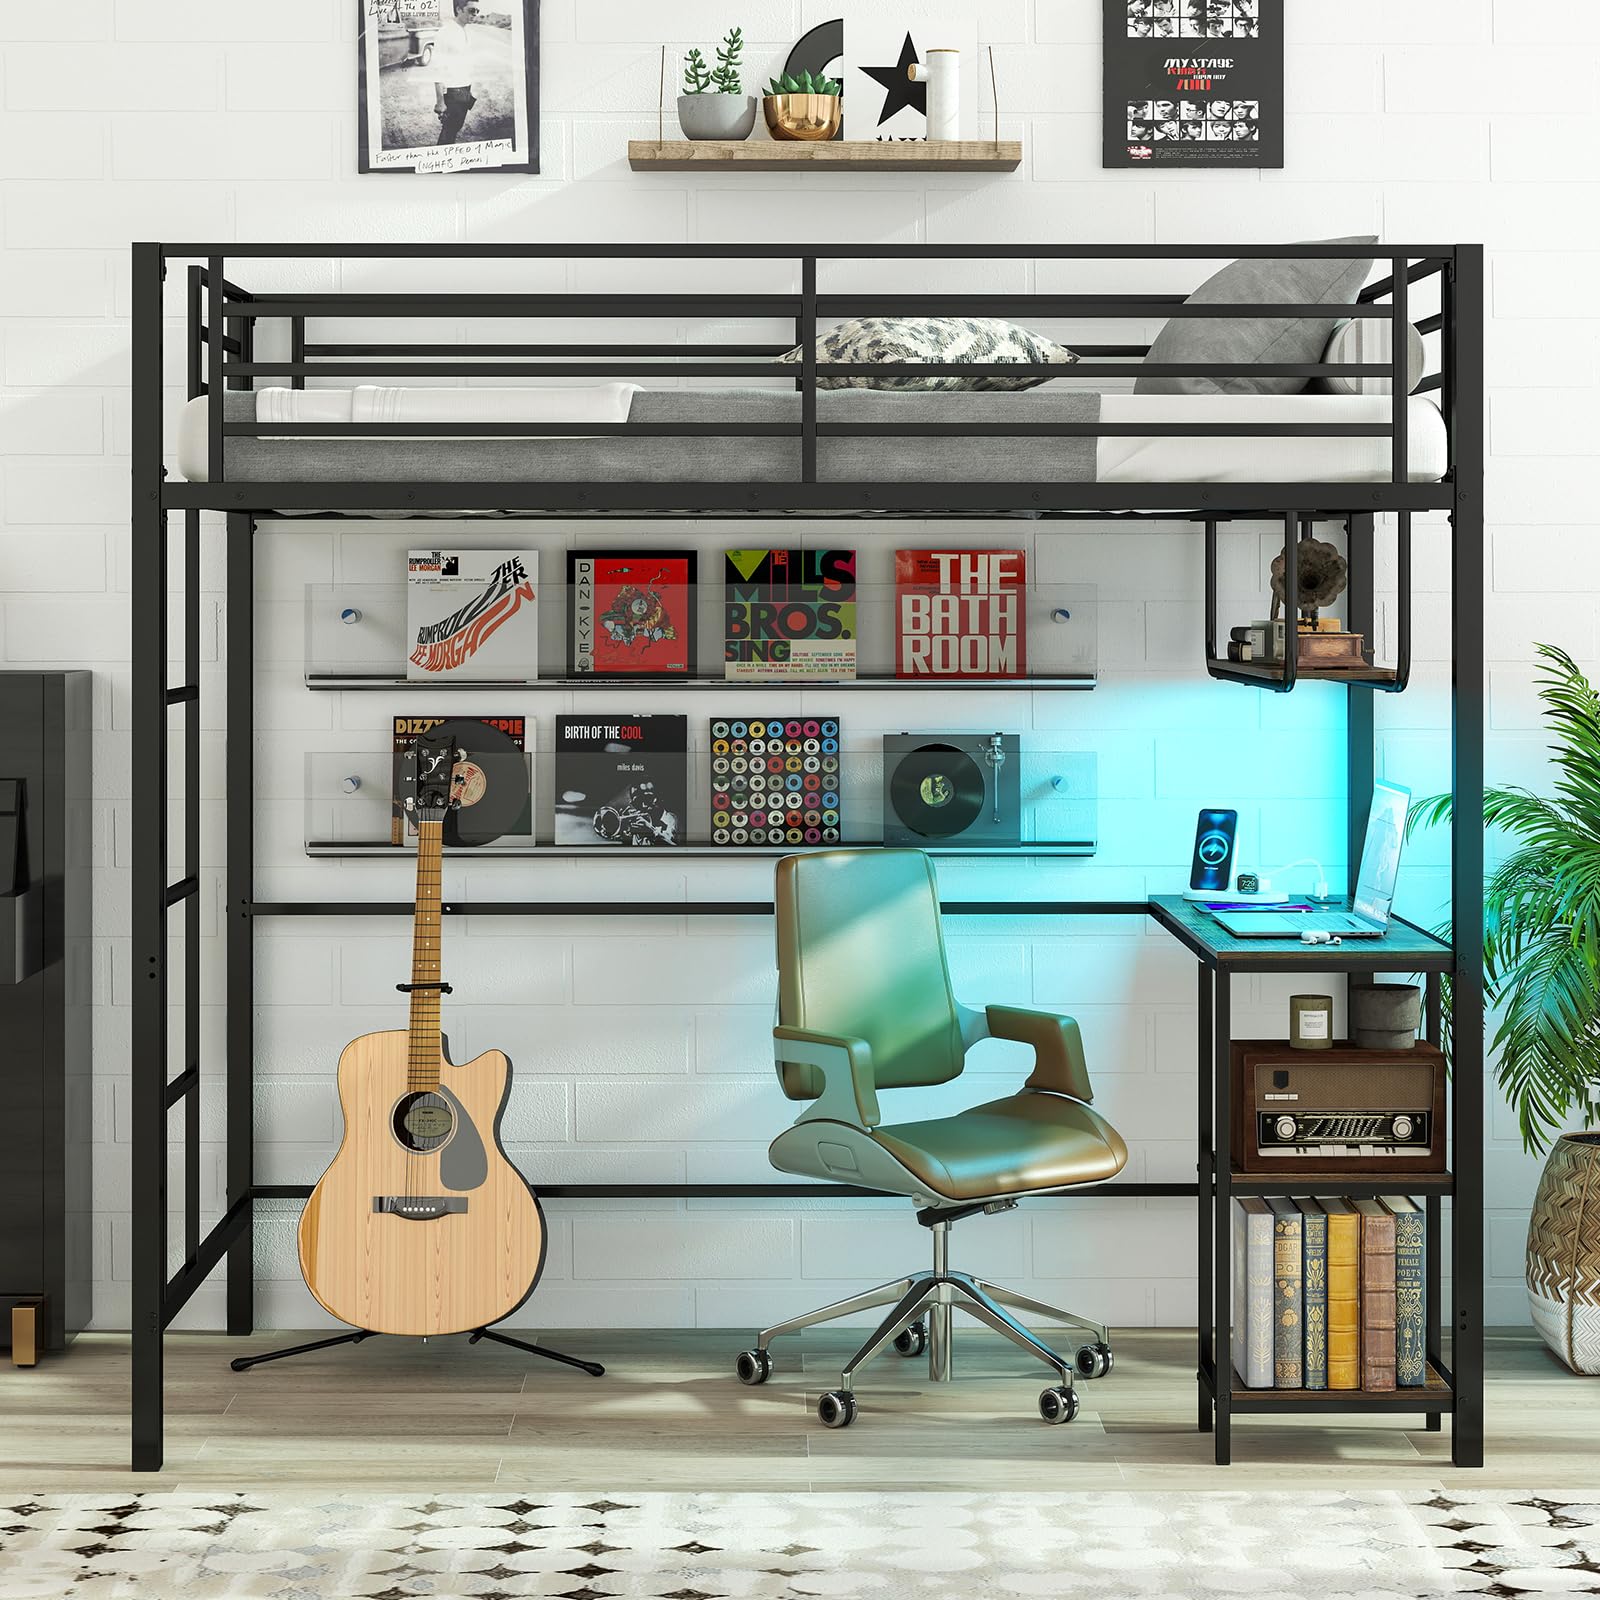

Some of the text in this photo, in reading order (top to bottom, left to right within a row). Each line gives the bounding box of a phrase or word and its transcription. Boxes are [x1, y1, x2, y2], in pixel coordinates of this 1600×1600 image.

[931, 554, 1018, 594] THE
[725, 602, 852, 640] BROS.
[901, 594, 1017, 634] BATH
[725, 640, 790, 662] SING
[902, 635, 1017, 673] ROOM
[564, 726, 643, 739] BIRTH OF THE COOL
[617, 763, 644, 771] miles davis
[1397, 1269, 1421, 1277] POETS
